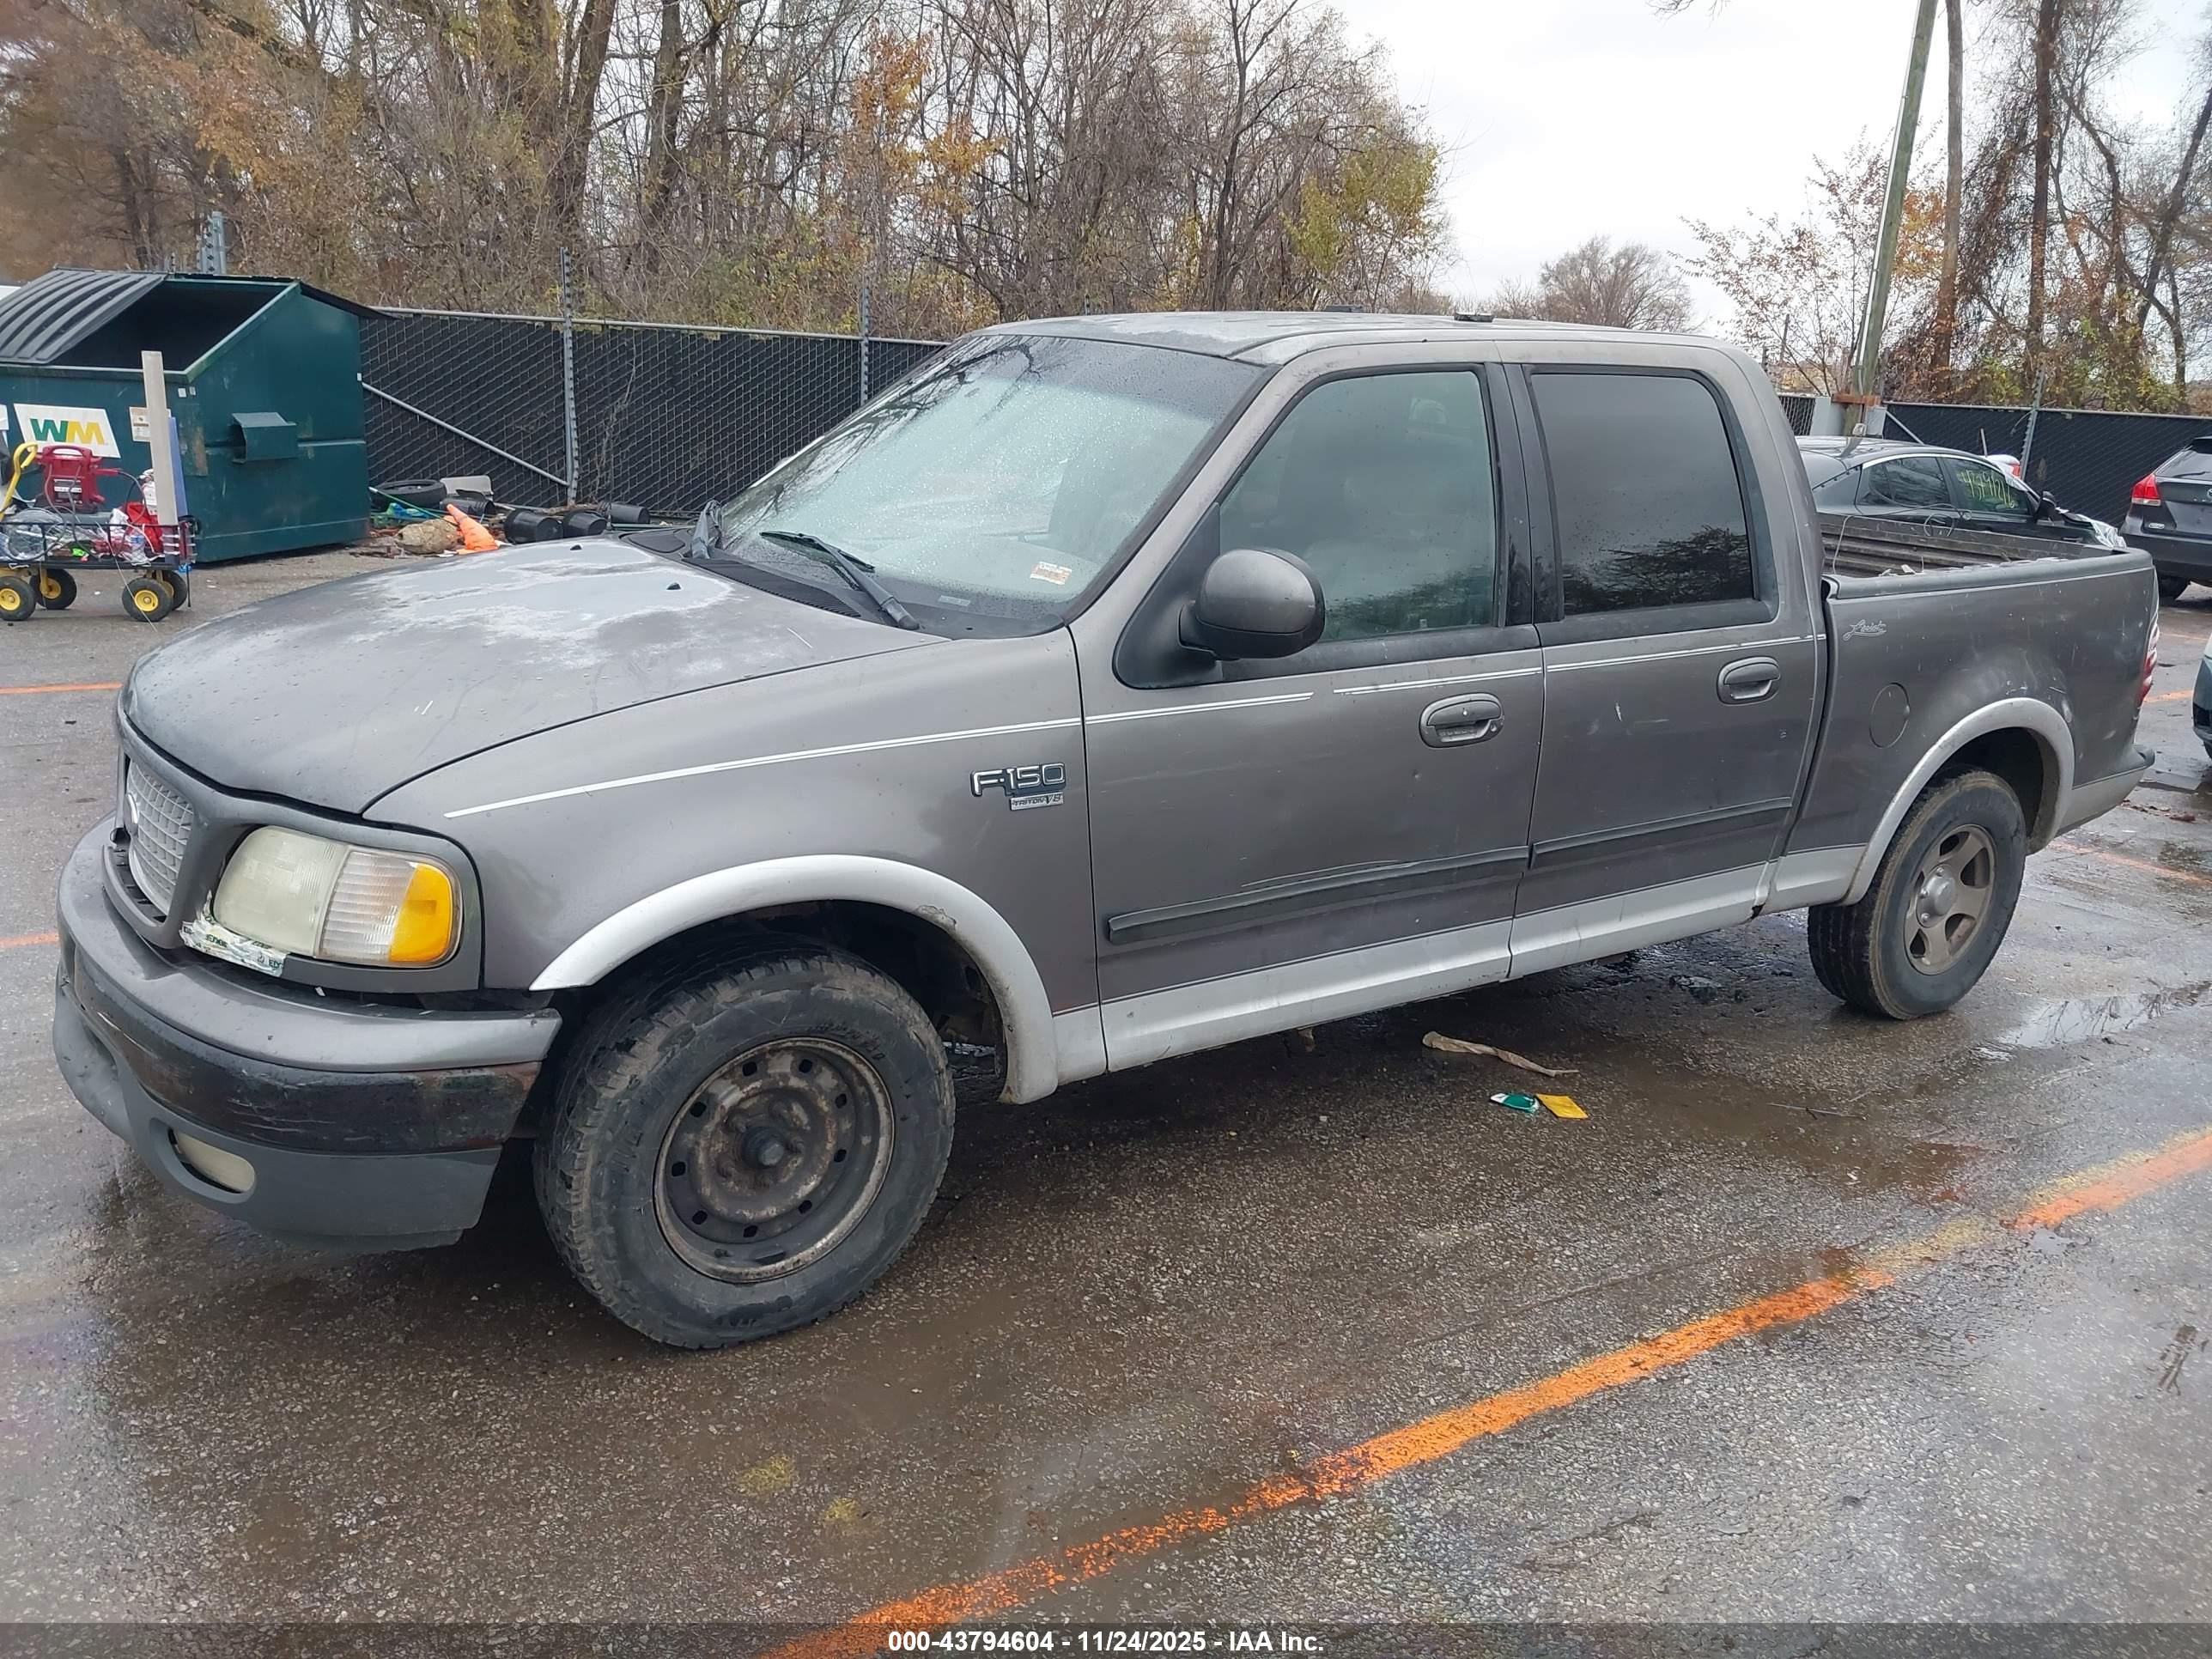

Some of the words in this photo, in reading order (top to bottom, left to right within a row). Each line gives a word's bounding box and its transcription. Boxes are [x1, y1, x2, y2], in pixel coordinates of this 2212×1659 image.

[29, 418, 106, 446] WM
[972, 763, 1066, 796] F-150
[1043, 793, 1062, 805] V8
